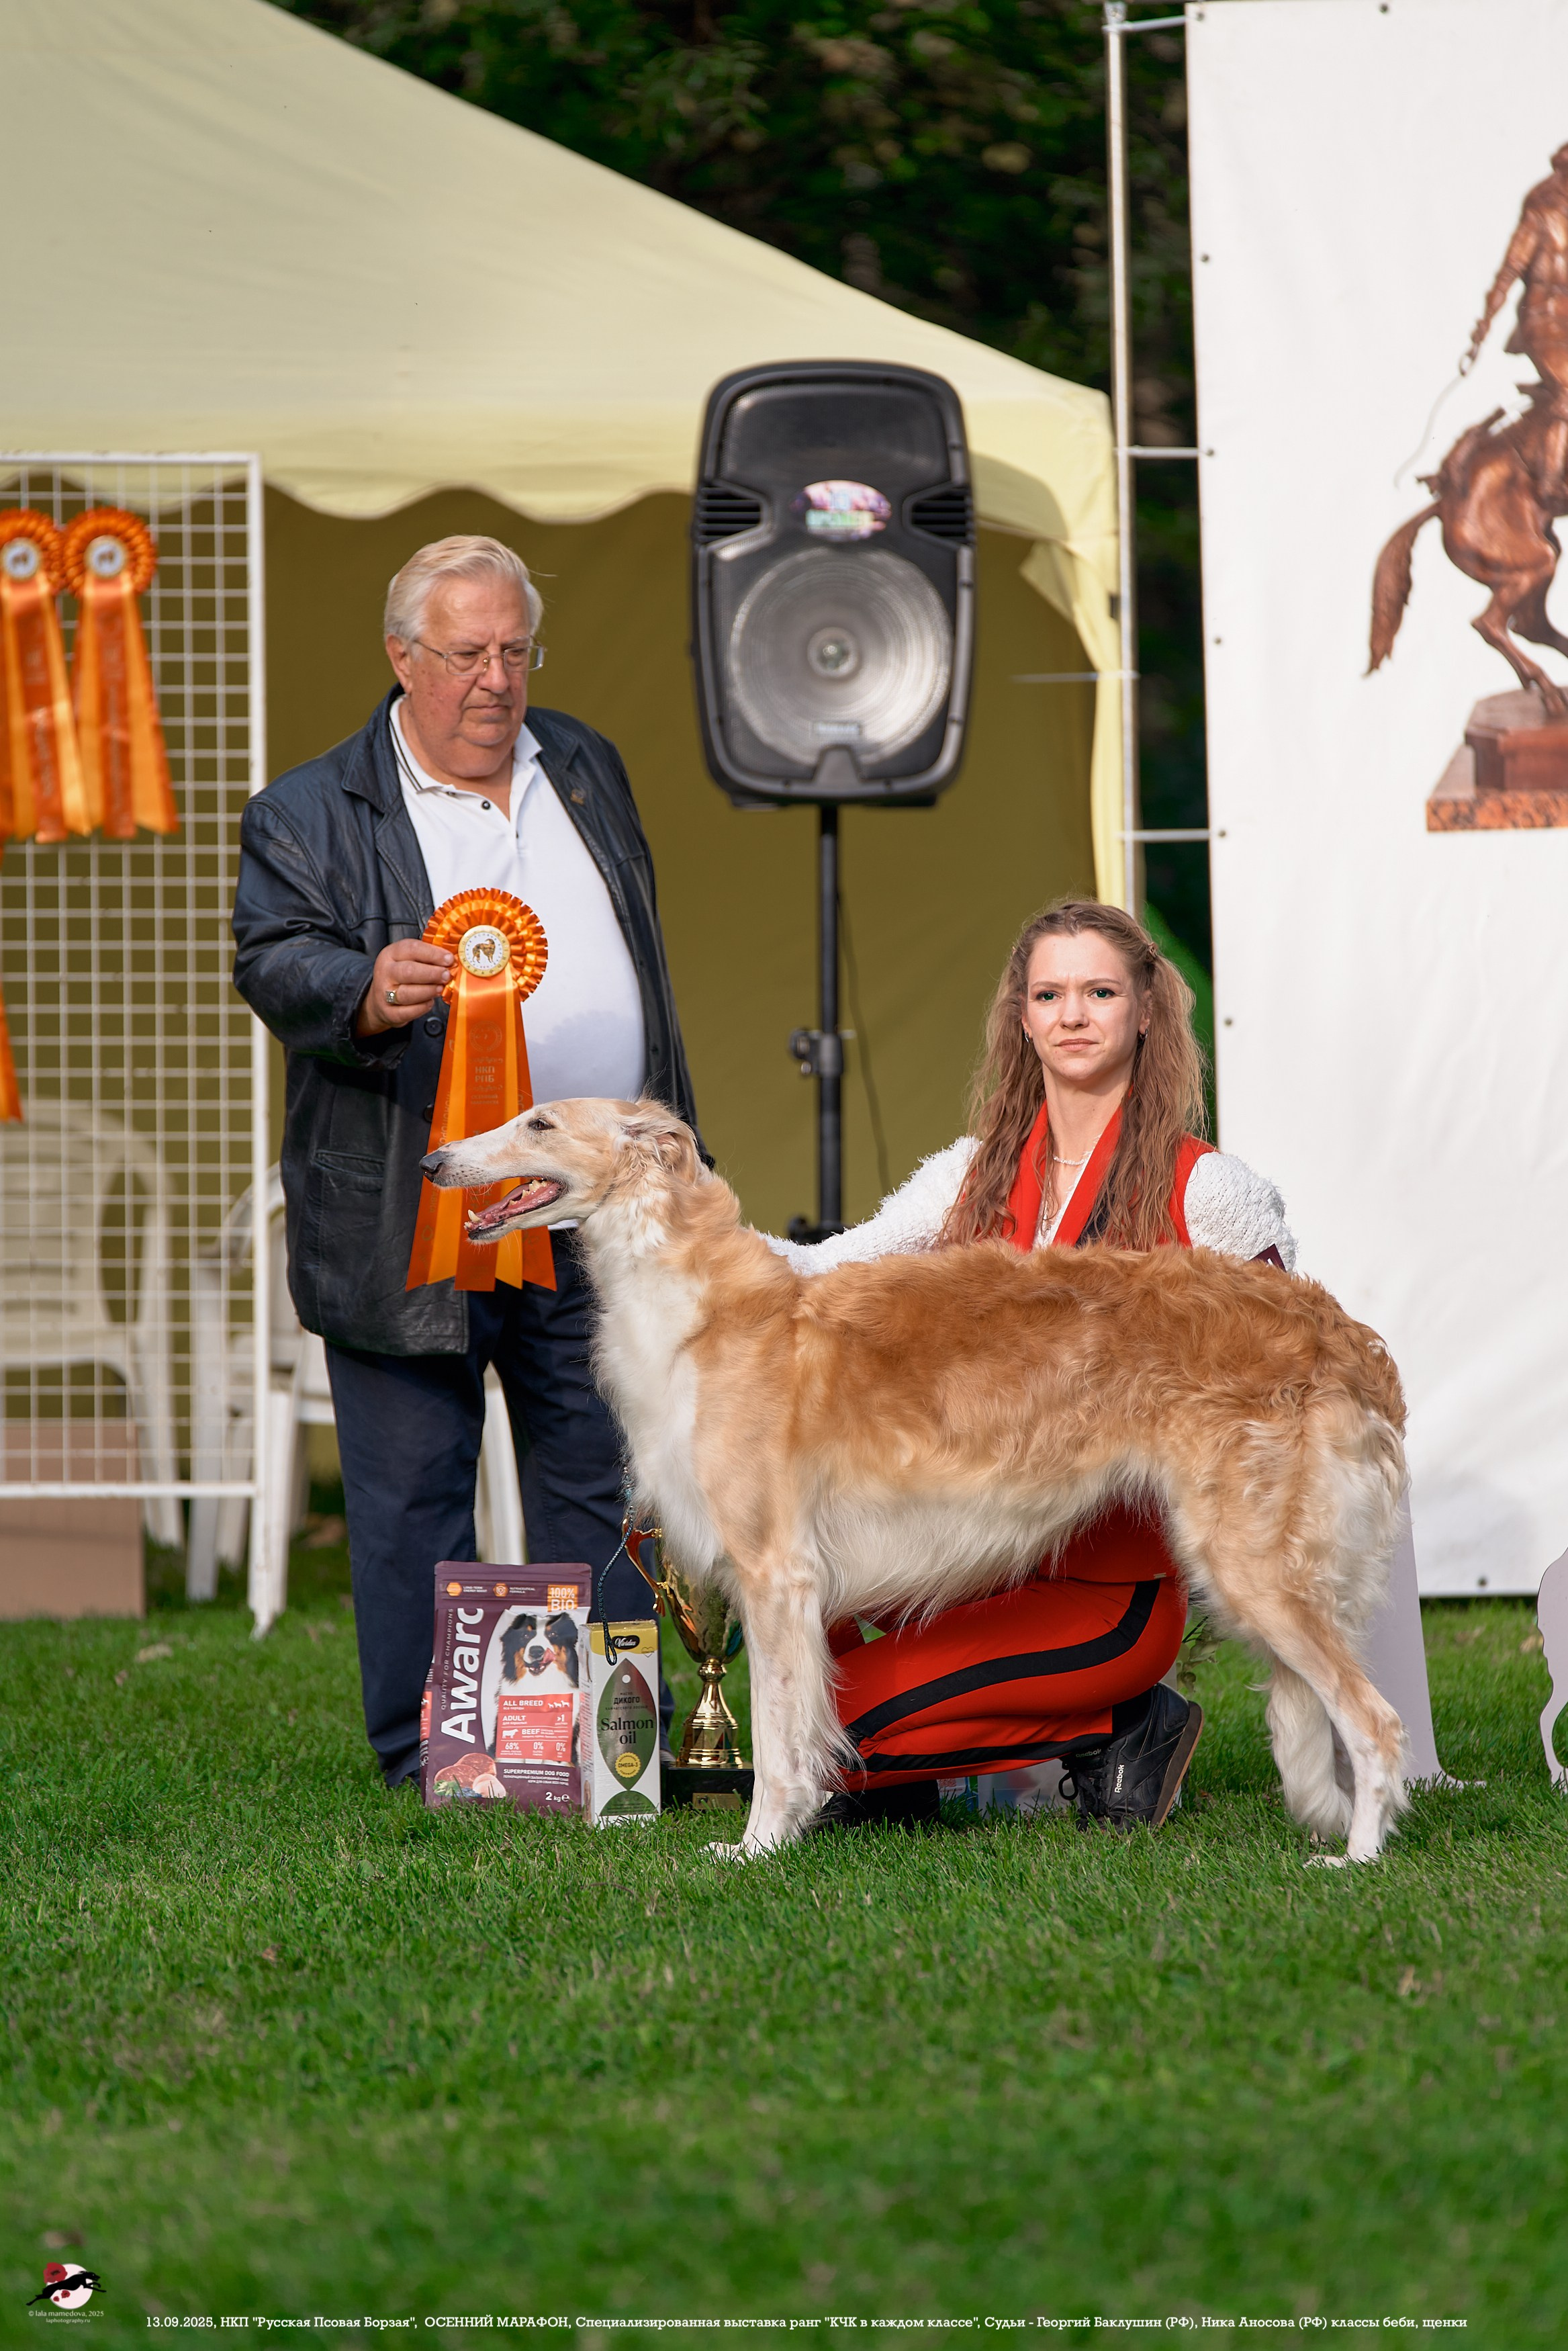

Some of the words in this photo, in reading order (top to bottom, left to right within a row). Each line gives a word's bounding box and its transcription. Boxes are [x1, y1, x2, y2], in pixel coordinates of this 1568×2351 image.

[474, 1075, 494, 1083] РПБ
[550, 1587, 575, 1599] 100%
[551, 1599, 575, 1611] BIO
[441, 1678, 449, 1710] QUALITY
[445, 1608, 453, 1656] CHAMPIONS
[441, 1607, 484, 1744] Awarc
[613, 1696, 641, 1705] ДИКОГО
[600, 1717, 654, 1731] Salmon
[619, 1731, 637, 1744] oil
[505, 1742, 520, 1750] 68%
[533, 1741, 544, 1750] 0%
[555, 1742, 566, 1752] 0%
[1115, 1764, 1125, 1793] Reebok
[545, 1791, 553, 1801] 2
